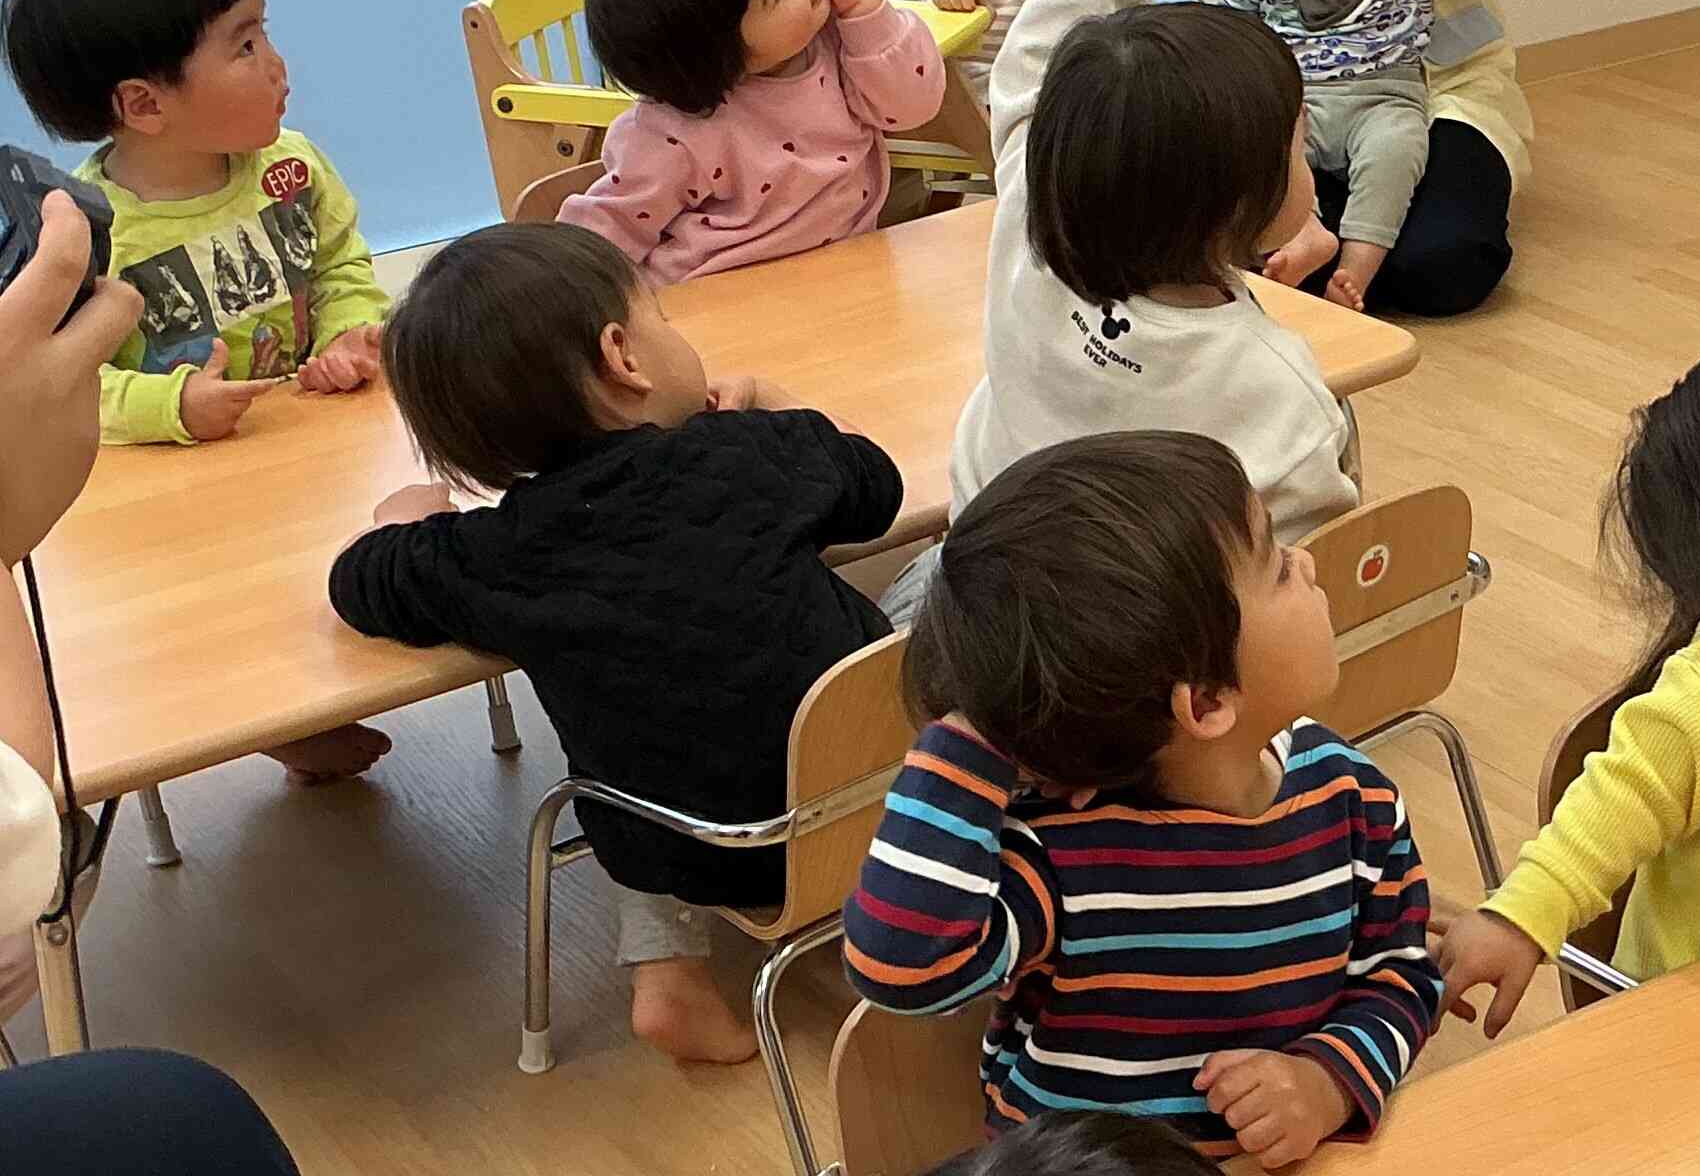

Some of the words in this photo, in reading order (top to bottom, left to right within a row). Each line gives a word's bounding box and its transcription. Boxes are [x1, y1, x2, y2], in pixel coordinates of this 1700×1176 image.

[266, 160, 306, 196] EPIC
[1071, 310, 1089, 336] BEST
[1089, 334, 1142, 374] HOLIDAYS
[1083, 343, 1107, 368] EVER
